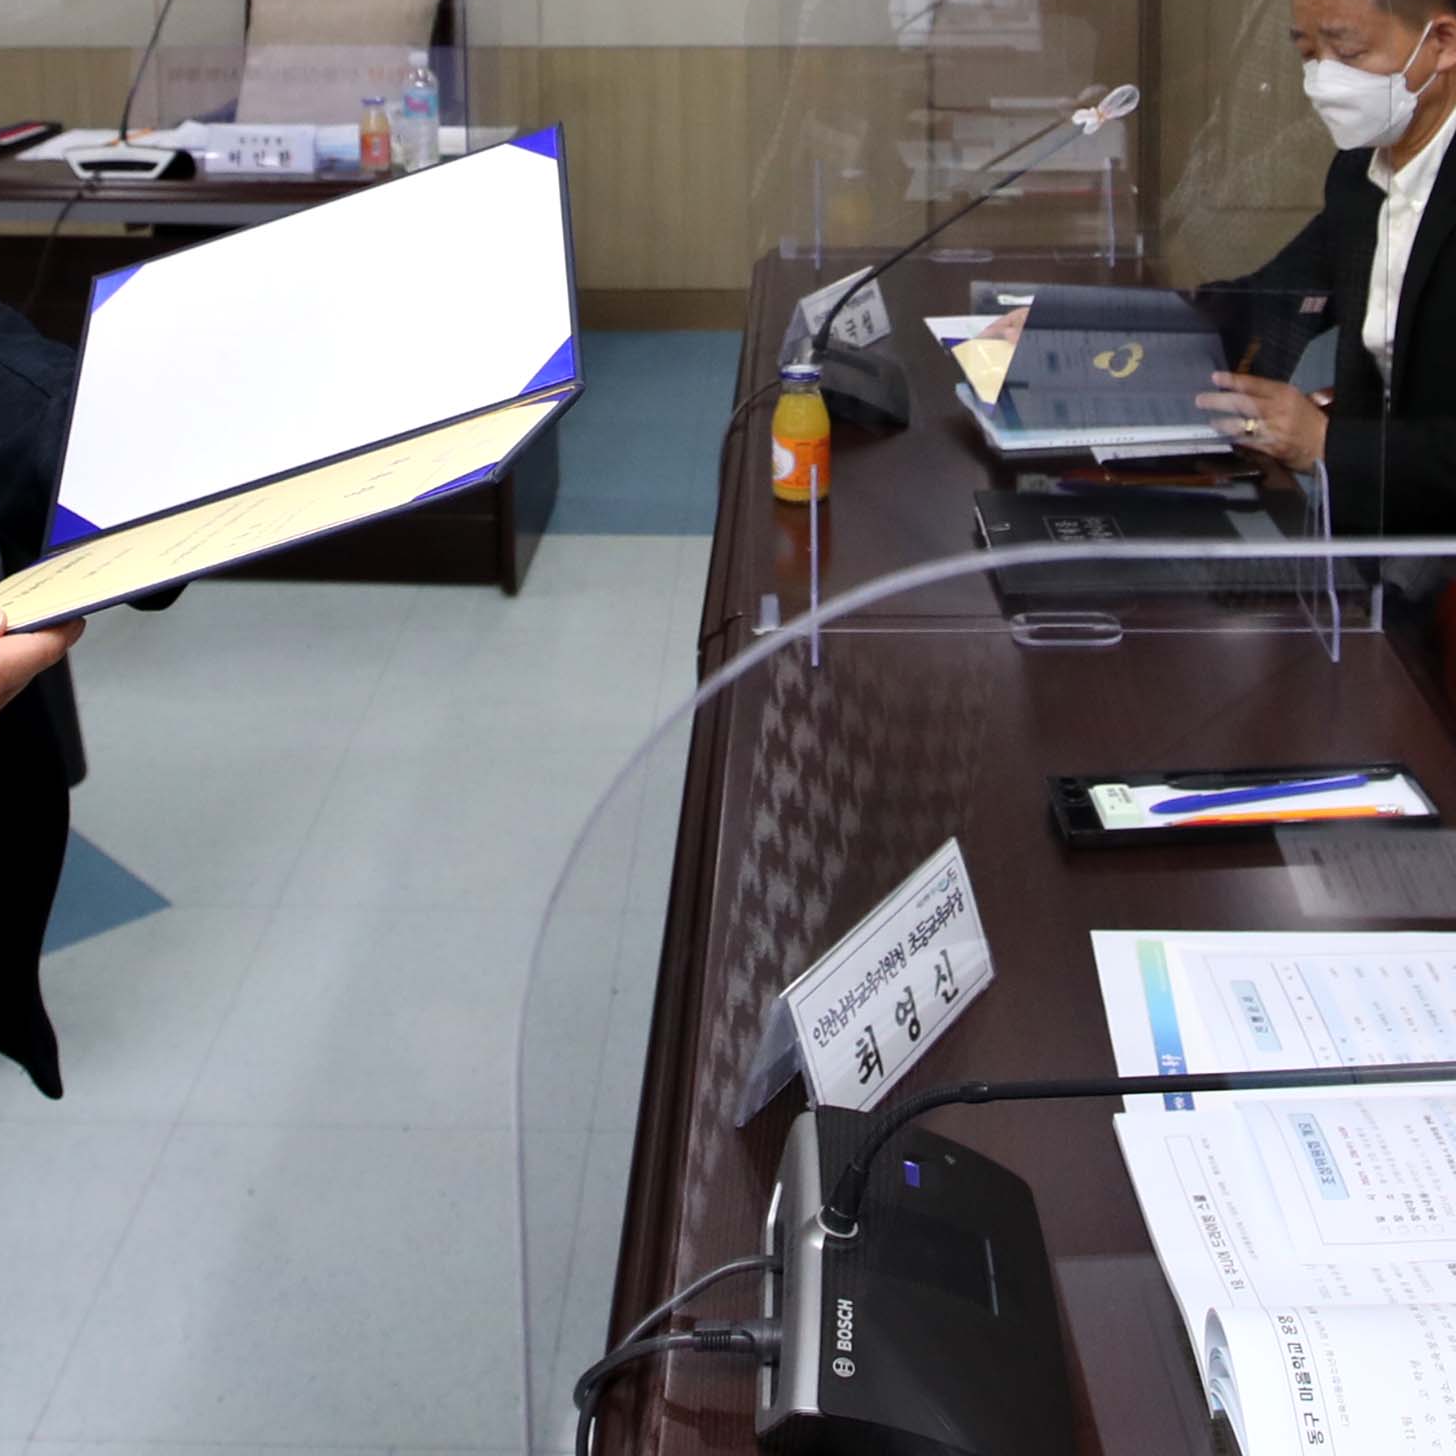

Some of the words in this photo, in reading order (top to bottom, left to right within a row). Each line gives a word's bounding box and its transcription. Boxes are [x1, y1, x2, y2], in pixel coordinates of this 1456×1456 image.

[836, 1298, 855, 1352] BOSCH
[1275, 1314, 1299, 1336] 운영
[1286, 1341, 1315, 1403] 마을학교
[1302, 1411, 1325, 1447] 동구
